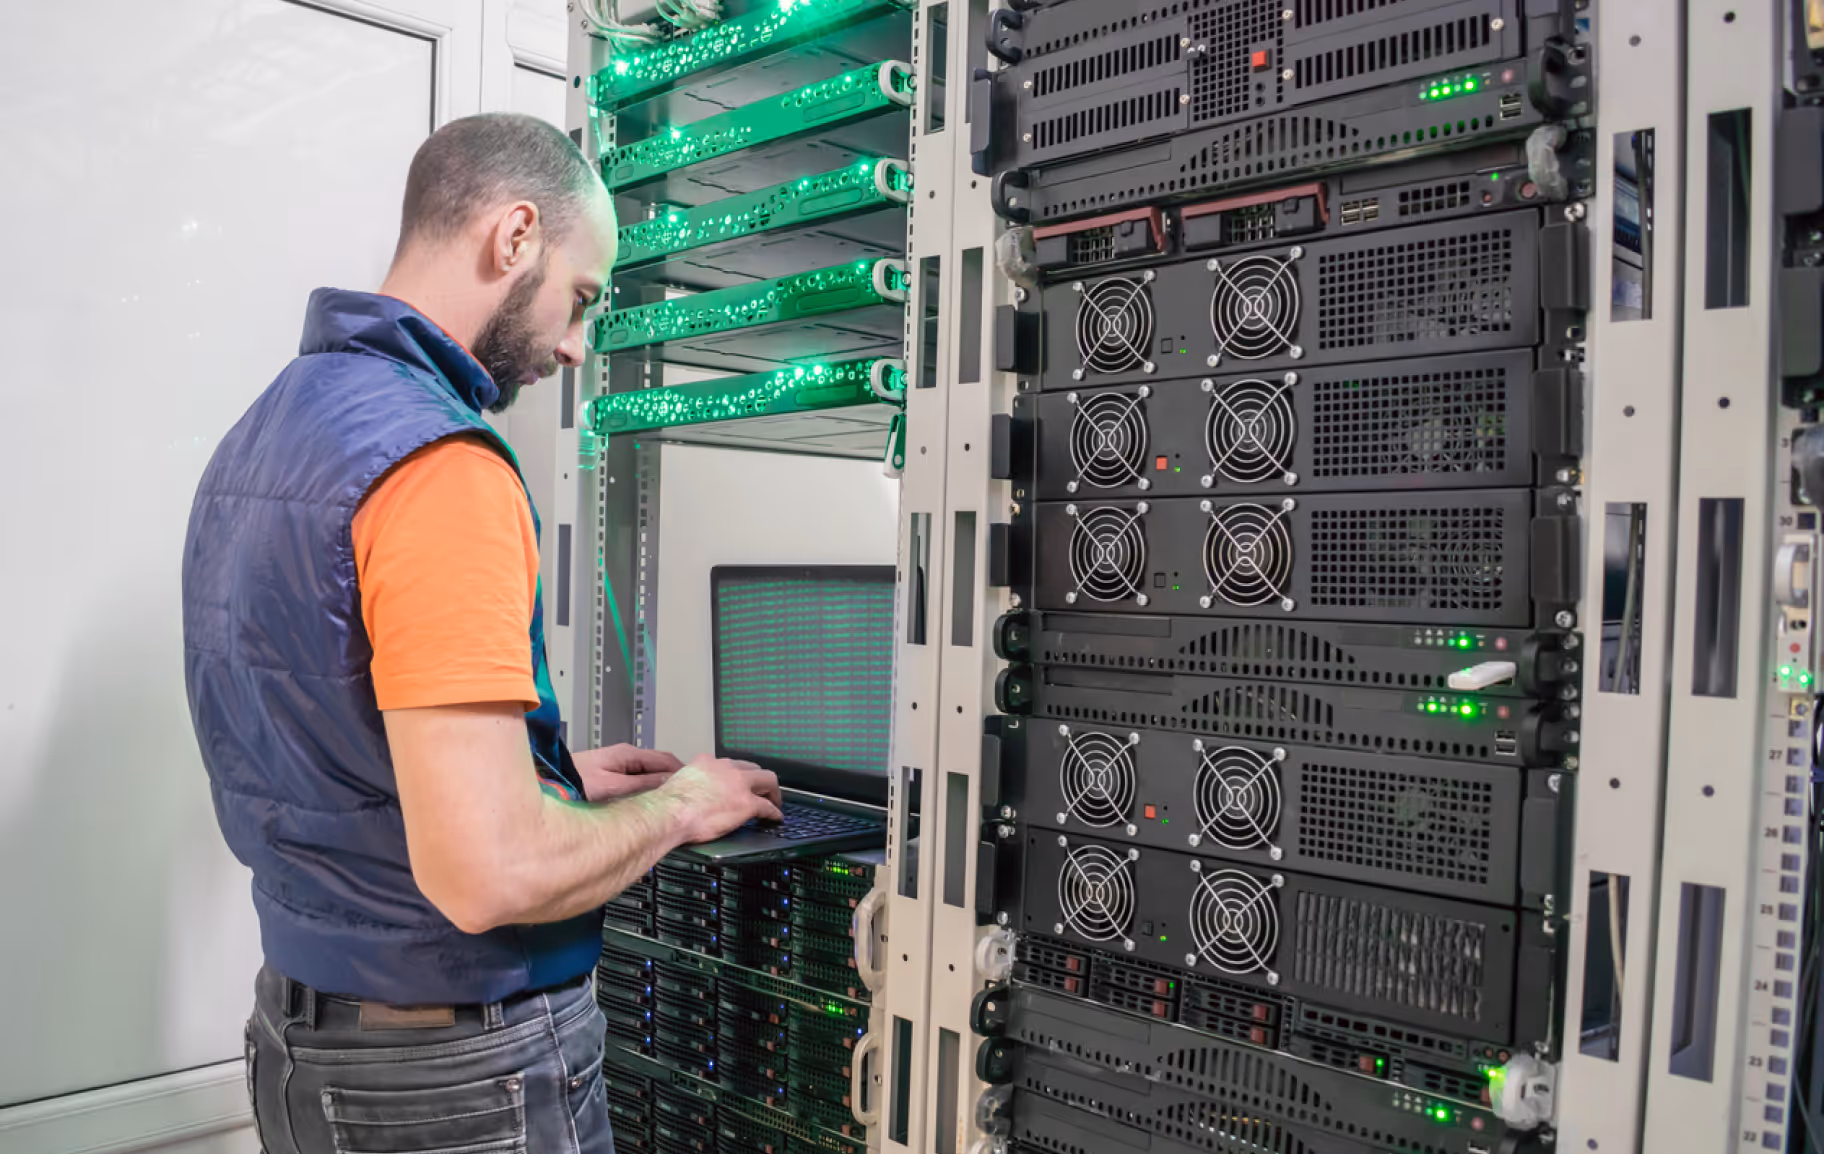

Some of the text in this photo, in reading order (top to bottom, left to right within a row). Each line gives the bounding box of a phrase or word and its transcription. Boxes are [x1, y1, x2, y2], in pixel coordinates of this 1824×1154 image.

[1780, 515, 1793, 527] 30
[1769, 749, 1783, 760] 27
[1765, 826, 1779, 838] 26
[1760, 903, 1774, 915] 25
[1755, 980, 1768, 991] 24
[1749, 1056, 1763, 1067] 23
[1743, 1131, 1757, 1142] 22
